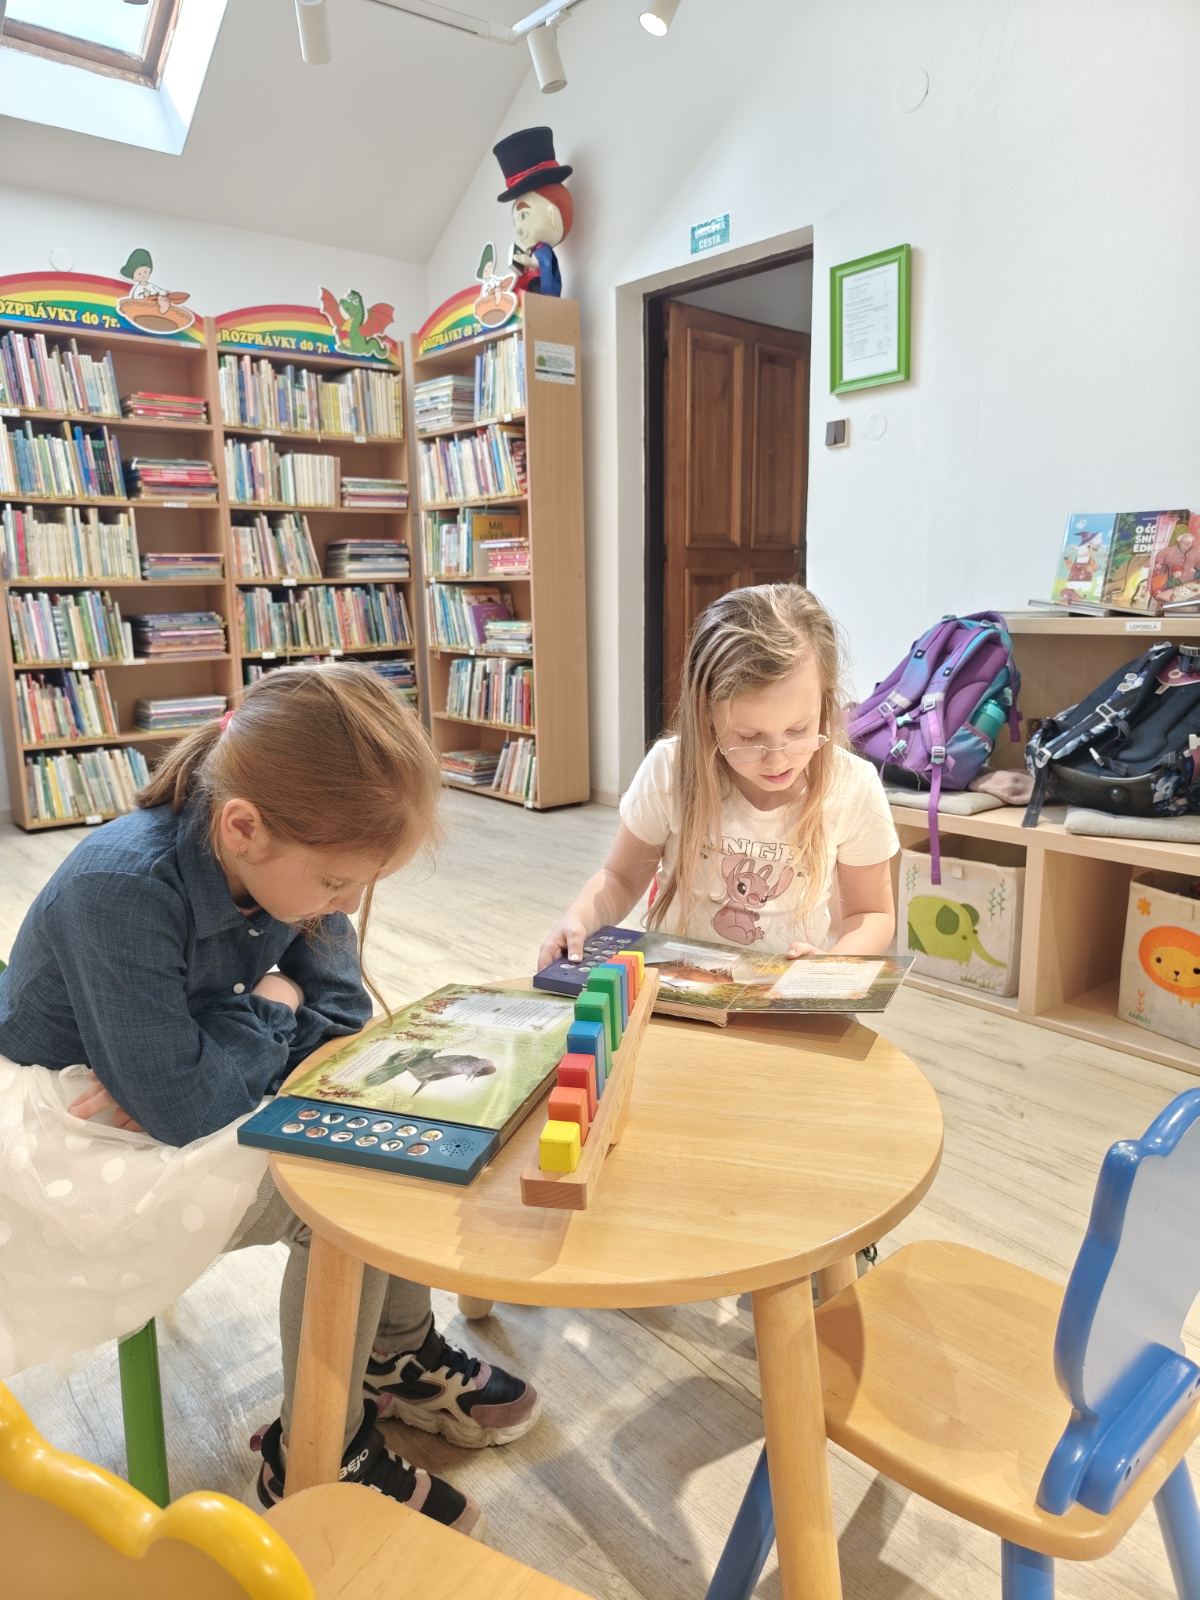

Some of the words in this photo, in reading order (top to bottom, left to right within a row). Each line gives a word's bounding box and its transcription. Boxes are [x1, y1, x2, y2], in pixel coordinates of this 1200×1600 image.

[81, 311, 99, 325] do
[220, 328, 297, 349] ROZPRÁVKY
[300, 339, 314, 350] do
[1135, 525, 1144, 534] O
